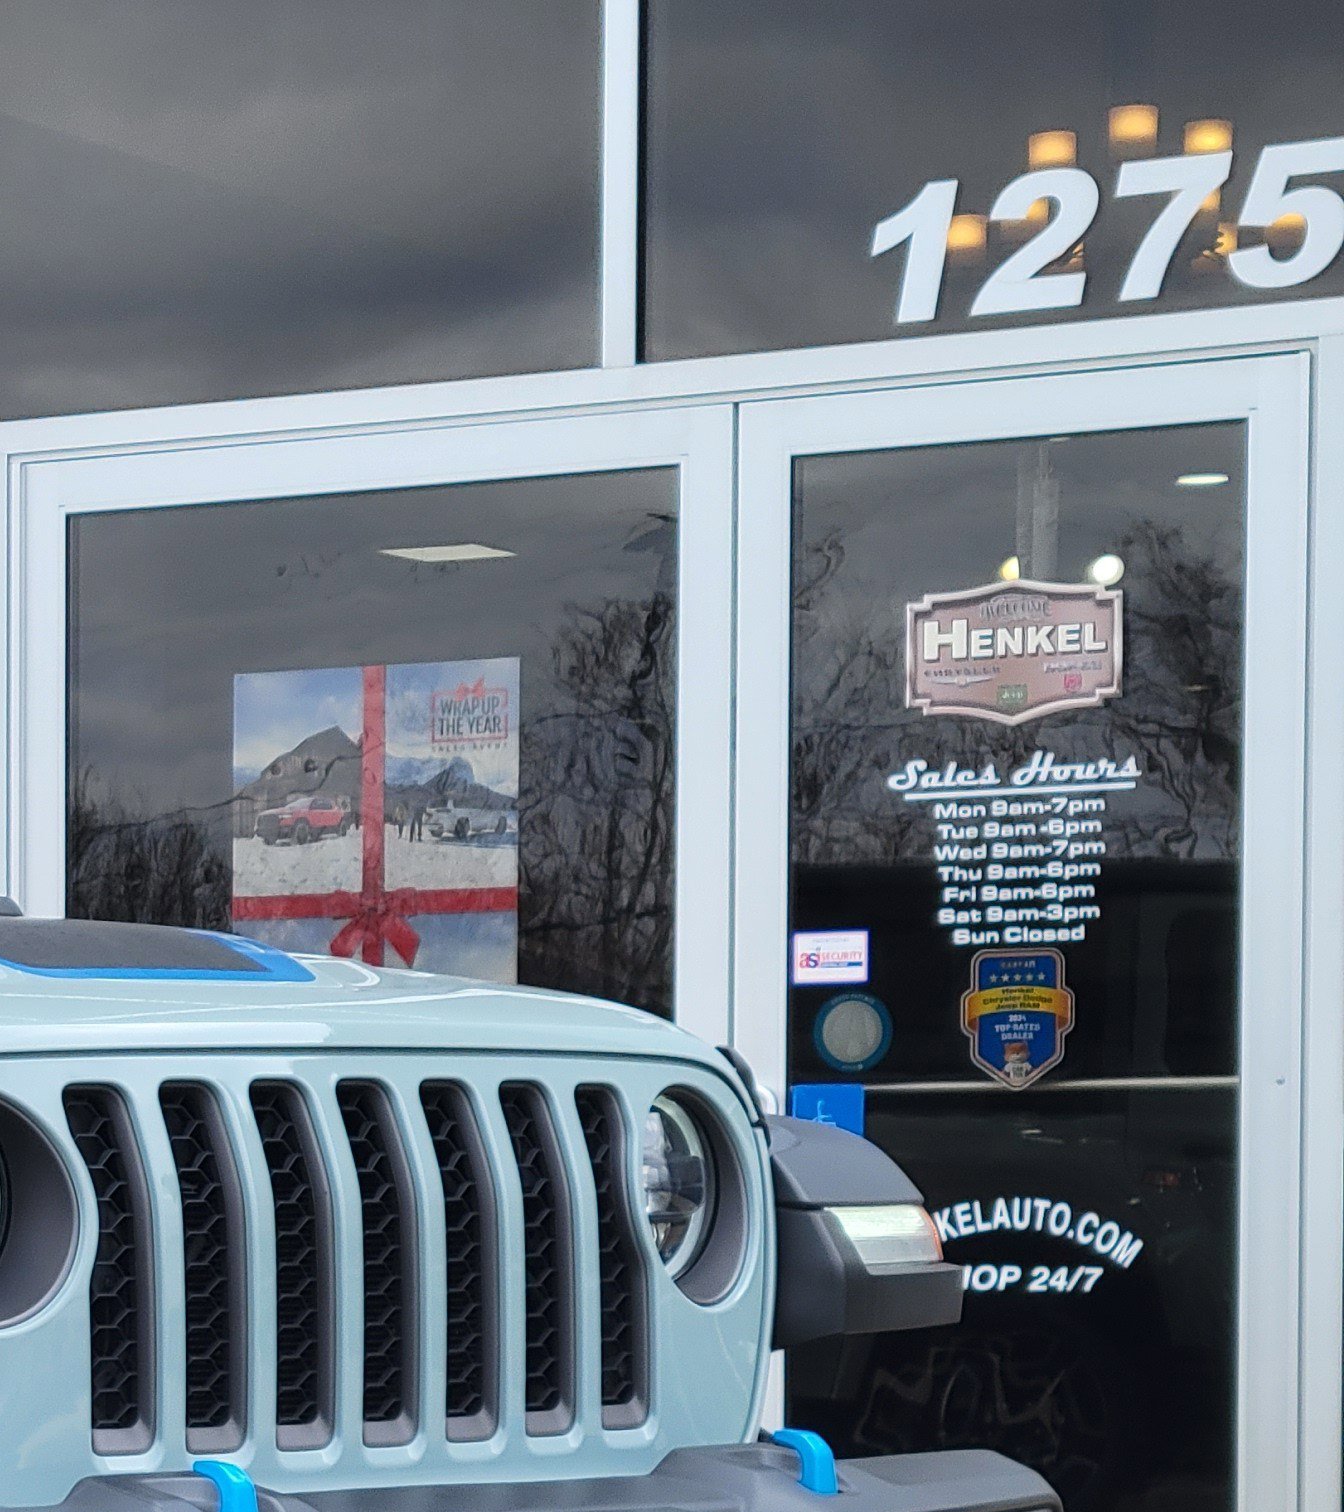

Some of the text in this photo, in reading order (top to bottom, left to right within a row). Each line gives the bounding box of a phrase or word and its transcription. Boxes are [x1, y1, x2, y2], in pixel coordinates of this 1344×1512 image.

[871, 137, 1344, 324] 1275
[923, 619, 1108, 661] HENKEL
[440, 696, 501, 717] WRAP UP
[438, 714, 502, 737] THE YEAR
[887, 750, 1142, 791] Sales Hours
[934, 796, 1106, 820] Mon 9am-7pm
[937, 822, 979, 840] Tue
[983, 821, 1037, 839] 9am
[934, 839, 1106, 861] Wed 9am-7pm
[937, 860, 1101, 883] Thu 9am-6pm
[943, 882, 1096, 903] Fri 9am-6pm
[937, 903, 1101, 925] Sat 9am-3pm
[952, 924, 1086, 946] Sun Closed
[821, 950, 864, 962] SECURITY
[933, 1196, 1144, 1269] KELAUTO.COM
[1026, 1264, 1105, 1293] 24/7
